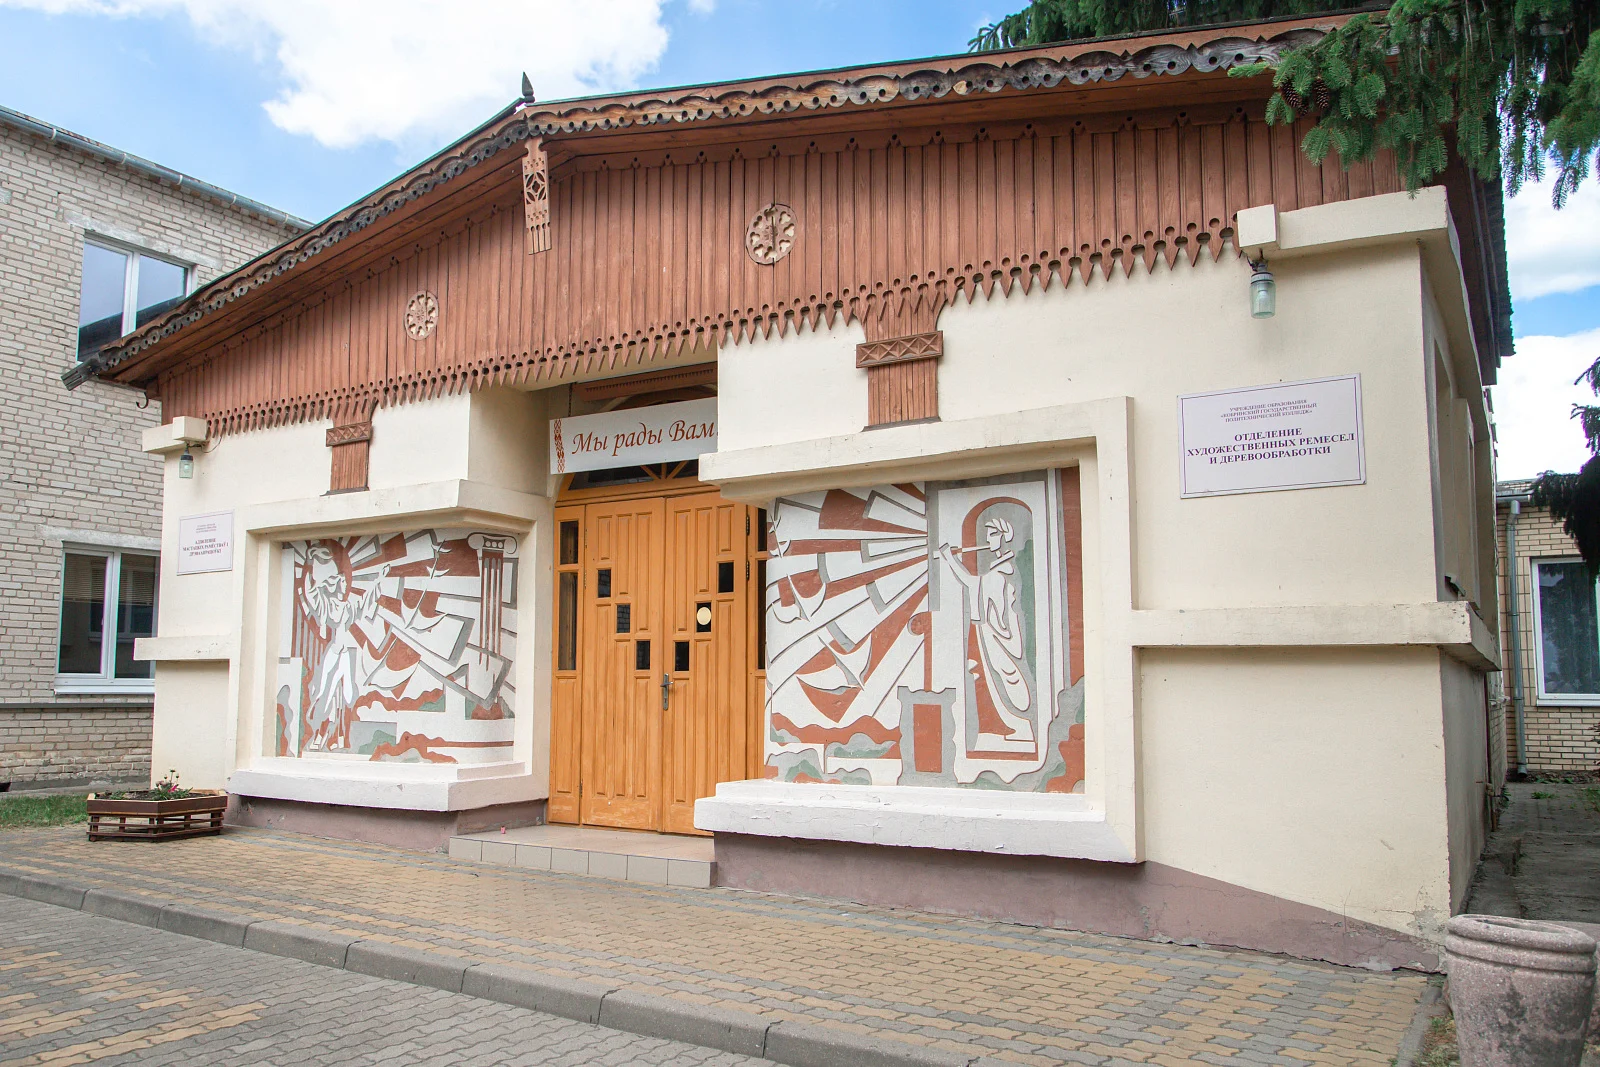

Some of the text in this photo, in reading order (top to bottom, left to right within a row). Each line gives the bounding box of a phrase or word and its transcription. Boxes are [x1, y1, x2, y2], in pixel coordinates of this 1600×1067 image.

[571, 431, 608, 455] Мы
[611, 422, 663, 456] рады
[1187, 433, 1355, 457] ХУДОЖЕСТВЕННЫХ РЕМЕСЕЛ
[1234, 428, 1303, 442] ОТДЕЛЕНИЕ
[1209, 446, 1332, 465] И ДЕРЕВООБРАБОТКИ
